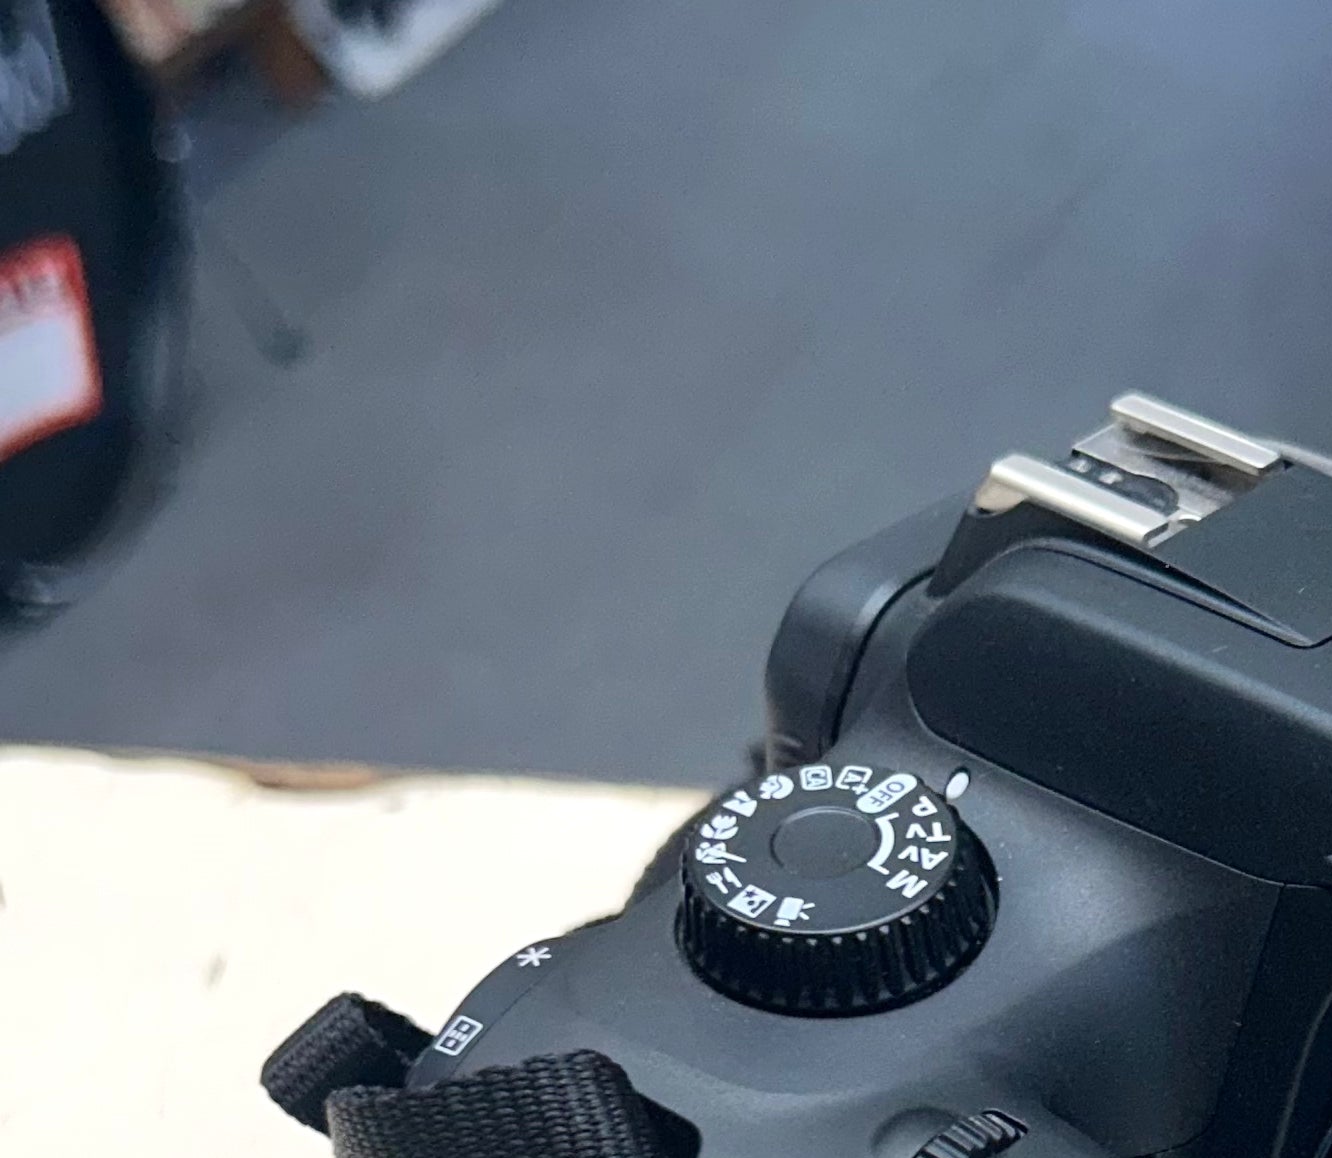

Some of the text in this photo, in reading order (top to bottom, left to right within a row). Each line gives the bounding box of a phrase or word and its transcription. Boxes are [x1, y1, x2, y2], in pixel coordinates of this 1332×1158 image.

[869, 781, 905, 807] OFF
[911, 795, 938, 817] P
[905, 821, 952, 843] Tv
[897, 844, 949, 871] Av
[885, 868, 929, 899] M
